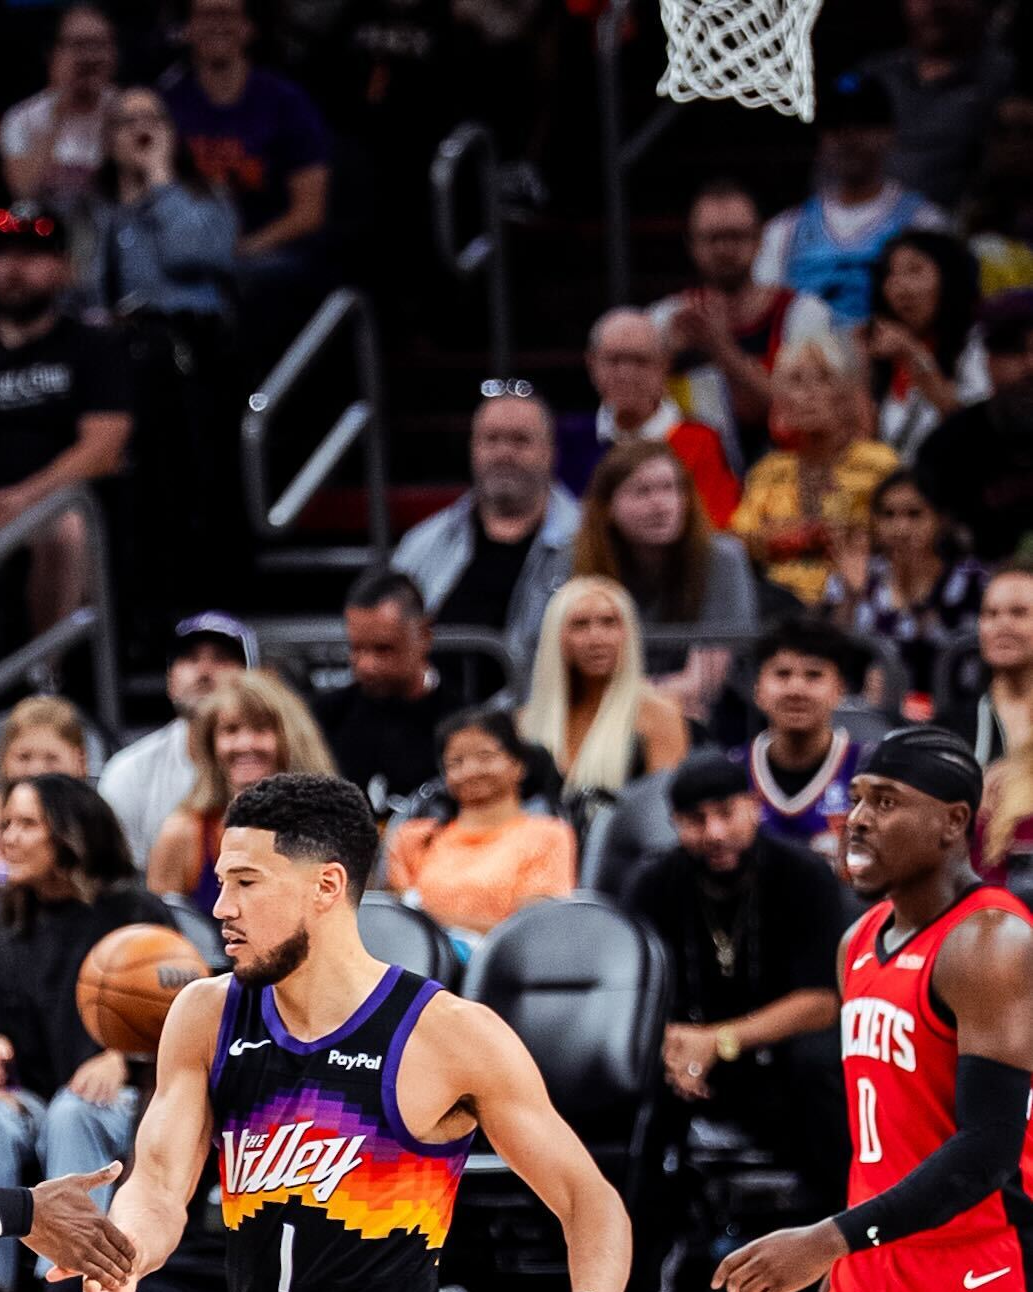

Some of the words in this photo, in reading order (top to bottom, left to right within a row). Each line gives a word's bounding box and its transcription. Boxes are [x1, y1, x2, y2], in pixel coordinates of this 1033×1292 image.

[327, 1050, 383, 1071] PayPal
[222, 1120, 367, 1203] Valley
[857, 1077, 883, 1164] 0
